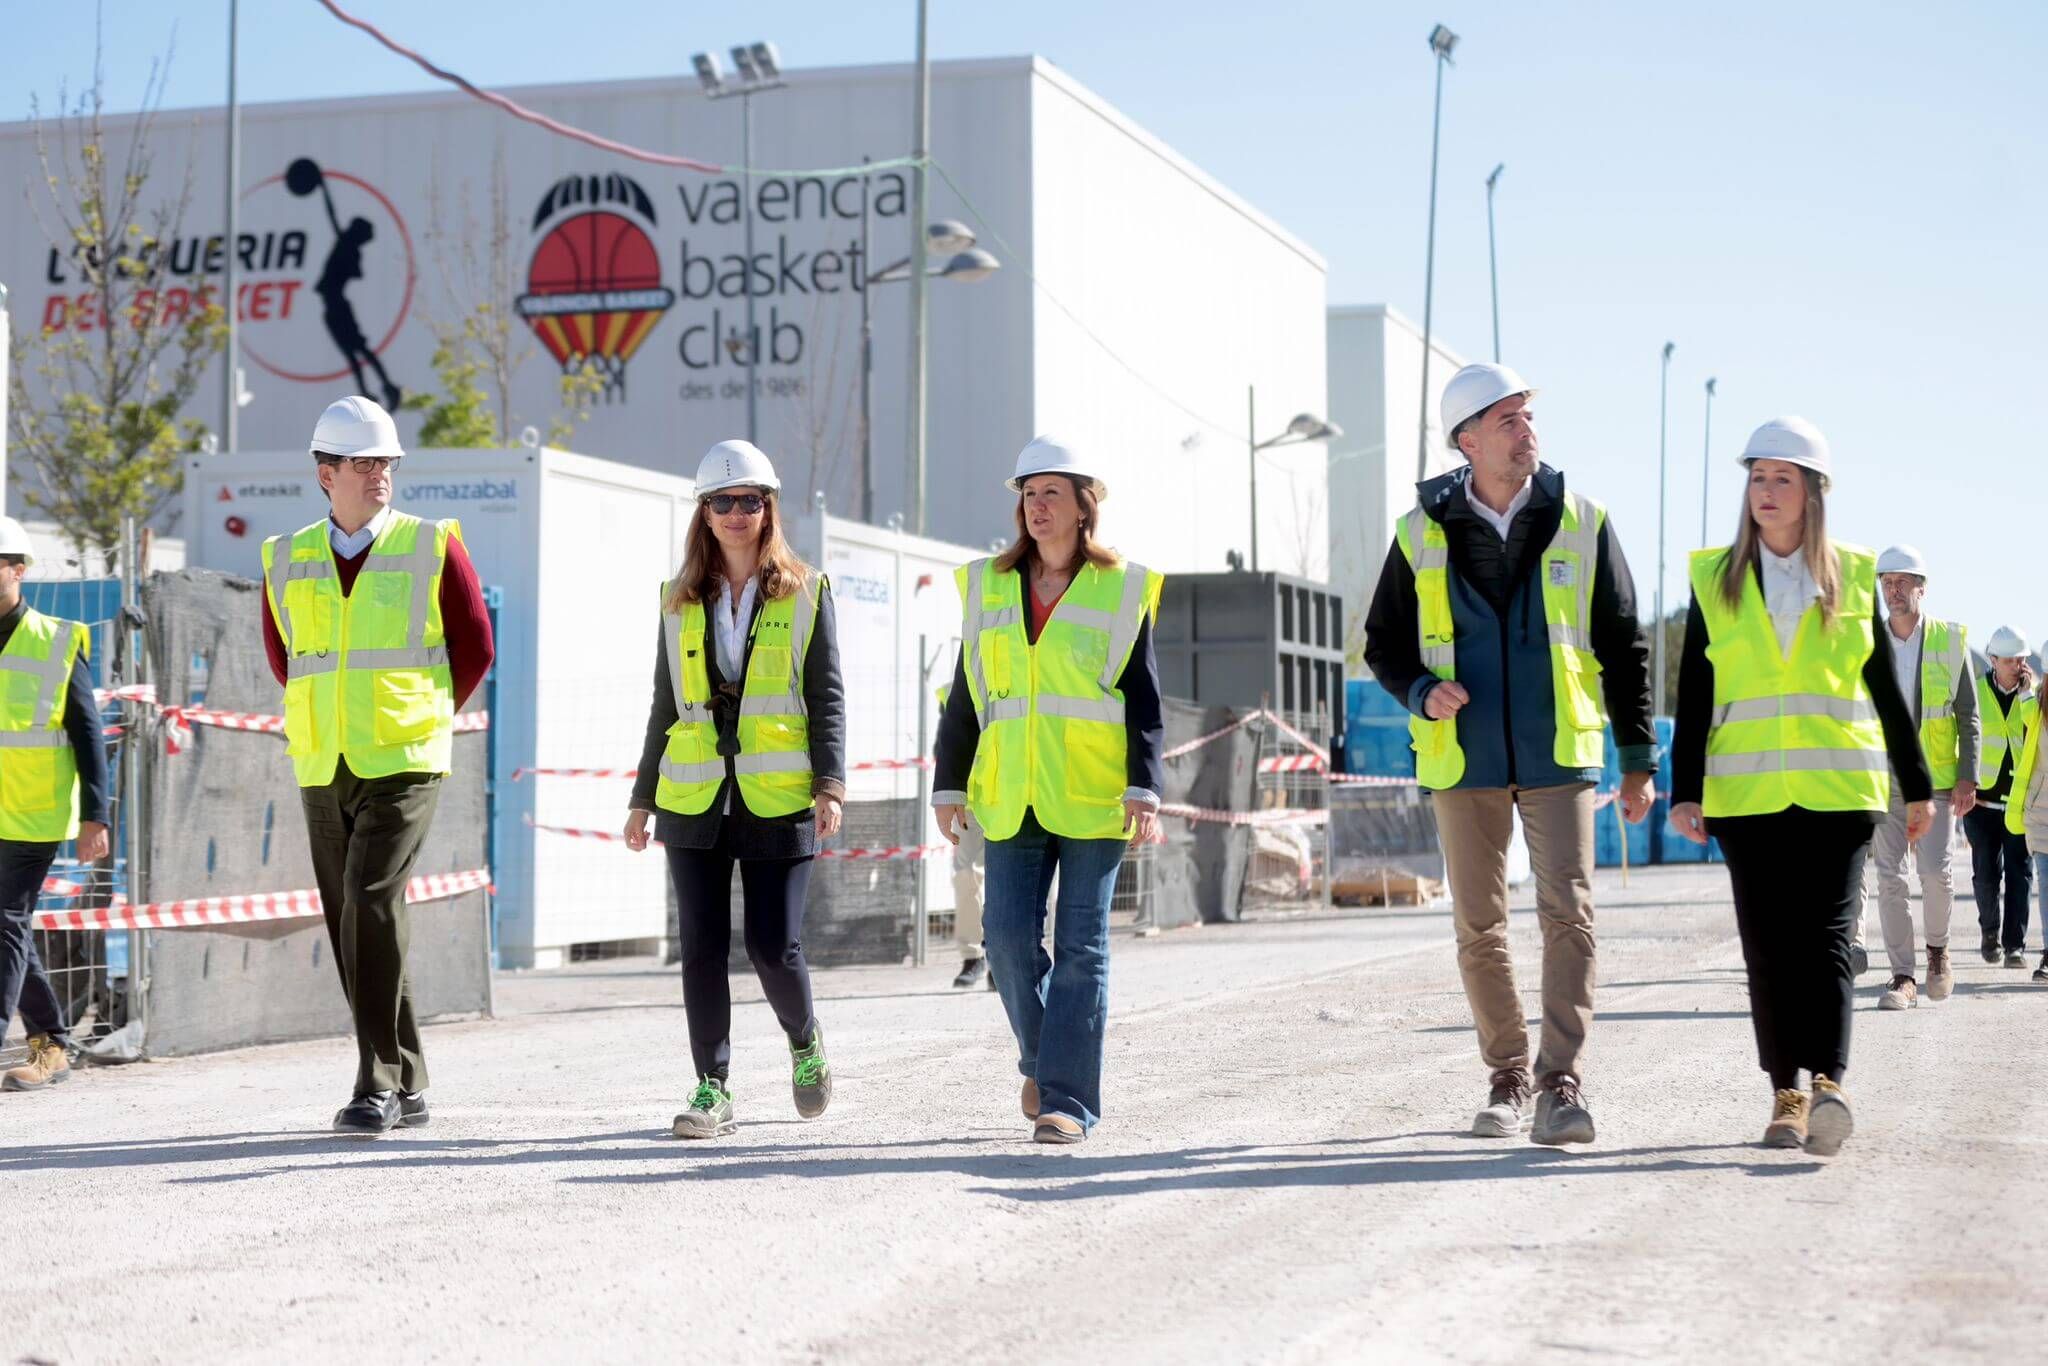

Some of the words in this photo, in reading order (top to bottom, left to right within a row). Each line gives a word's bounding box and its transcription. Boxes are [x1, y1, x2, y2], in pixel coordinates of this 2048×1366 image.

[678, 171, 905, 225] vaenca
[681, 235, 866, 299] basket
[130, 280, 304, 331] BASET
[679, 307, 805, 369] club
[402, 478, 518, 501] ormazabal
